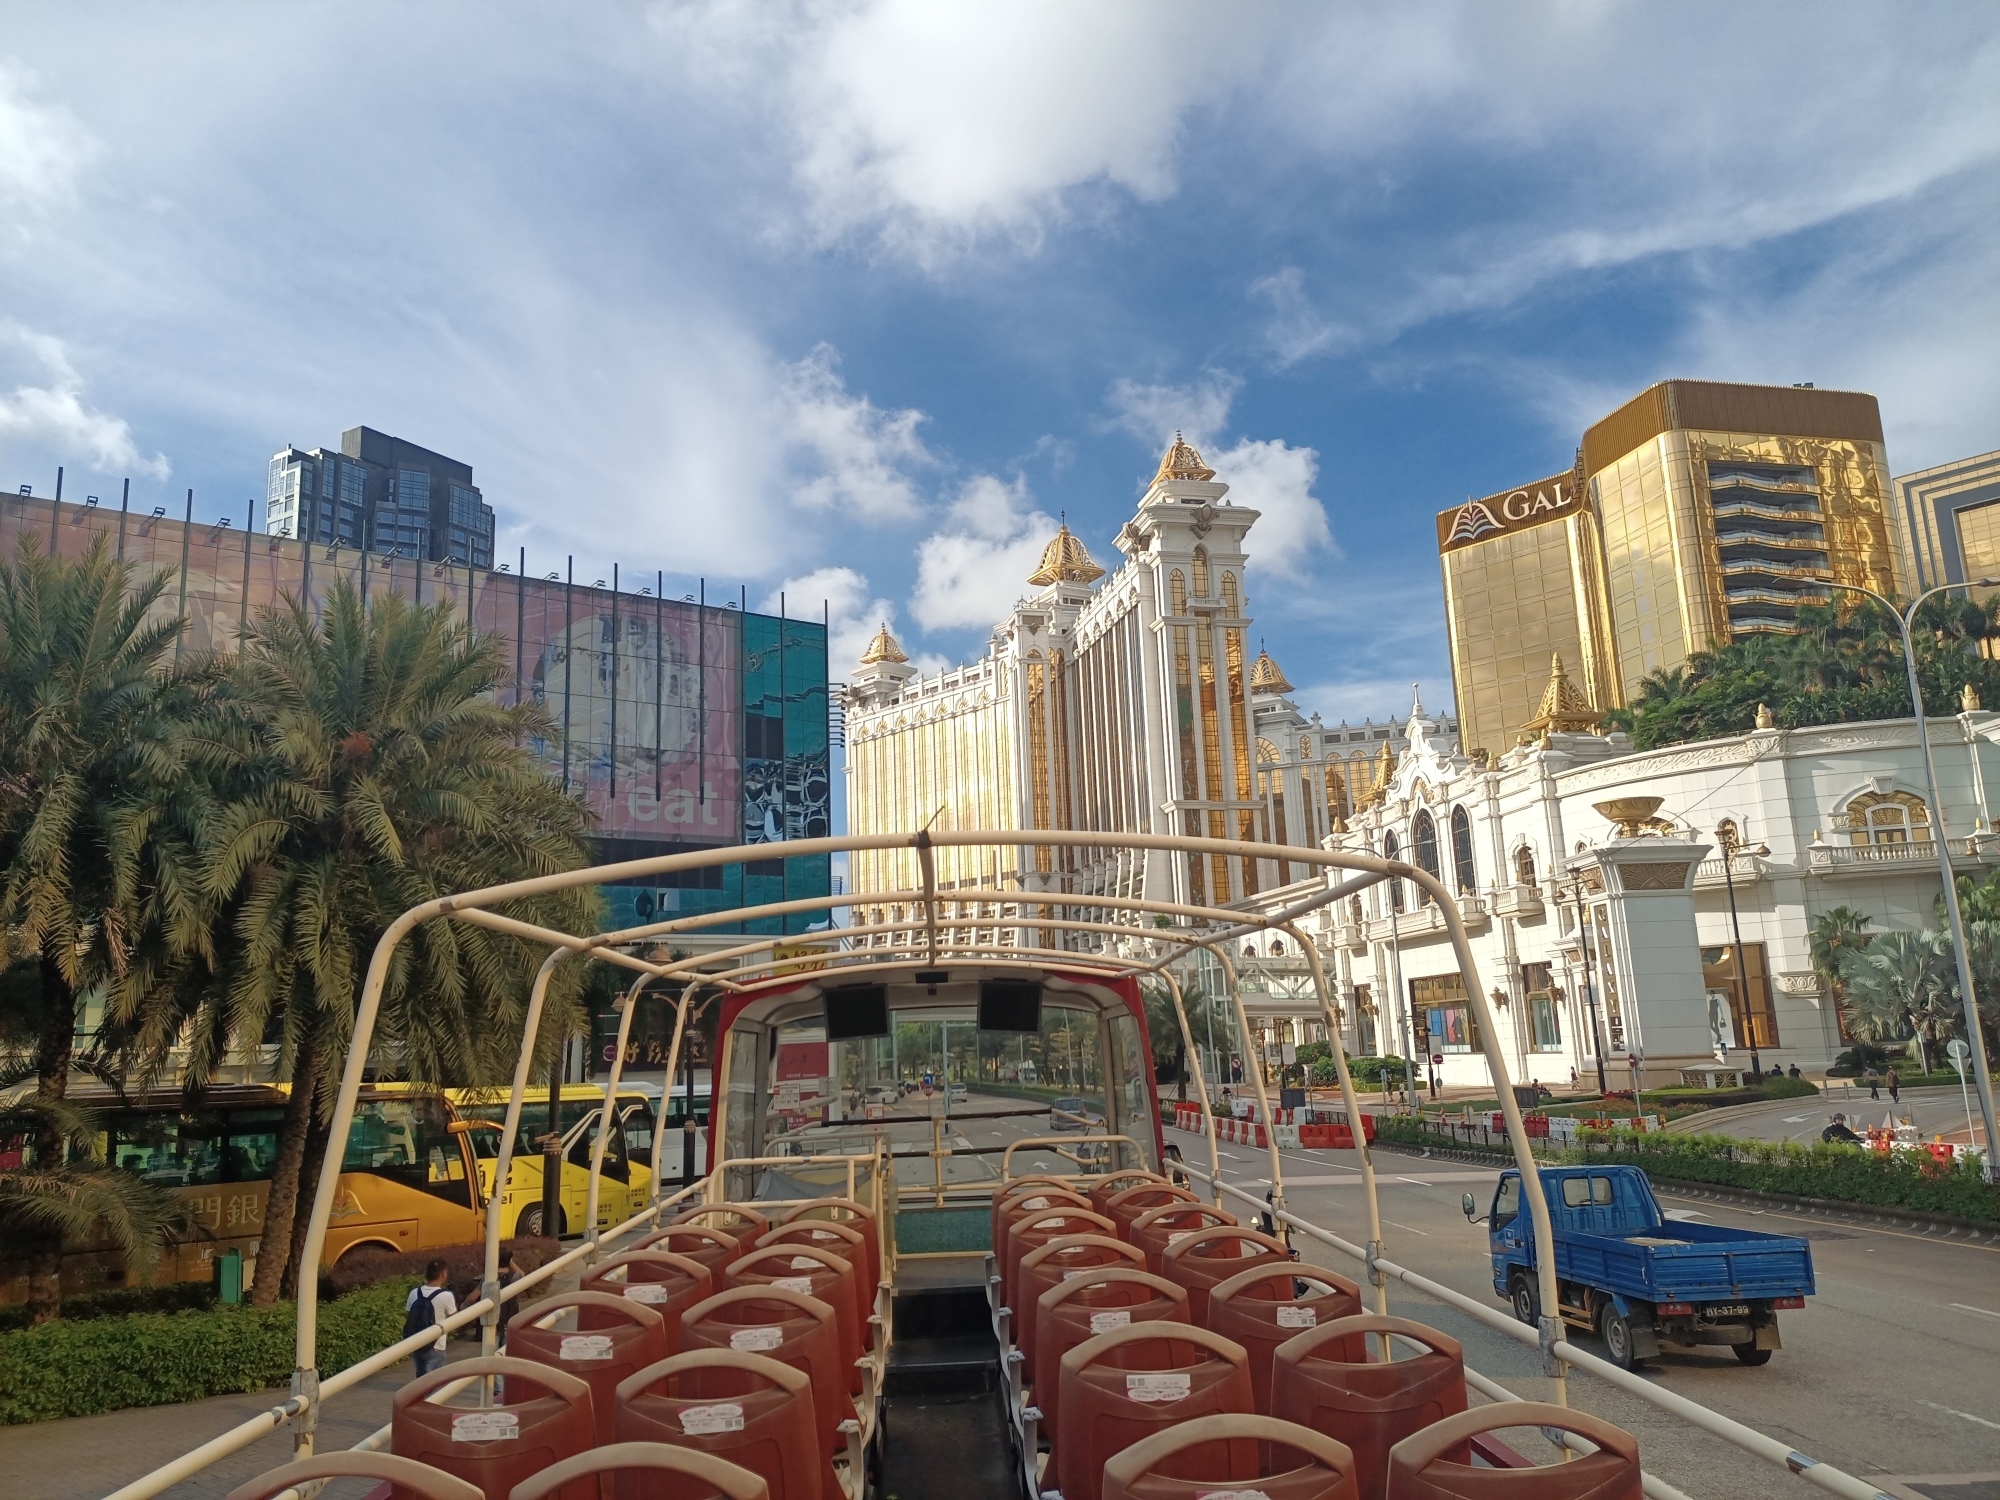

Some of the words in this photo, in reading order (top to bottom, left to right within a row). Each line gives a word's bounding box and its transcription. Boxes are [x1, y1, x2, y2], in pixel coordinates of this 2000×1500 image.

[1502, 482, 1572, 521] GAL
[627, 781, 718, 826] eat
[1597, 907, 1619, 1014] GALAXY
